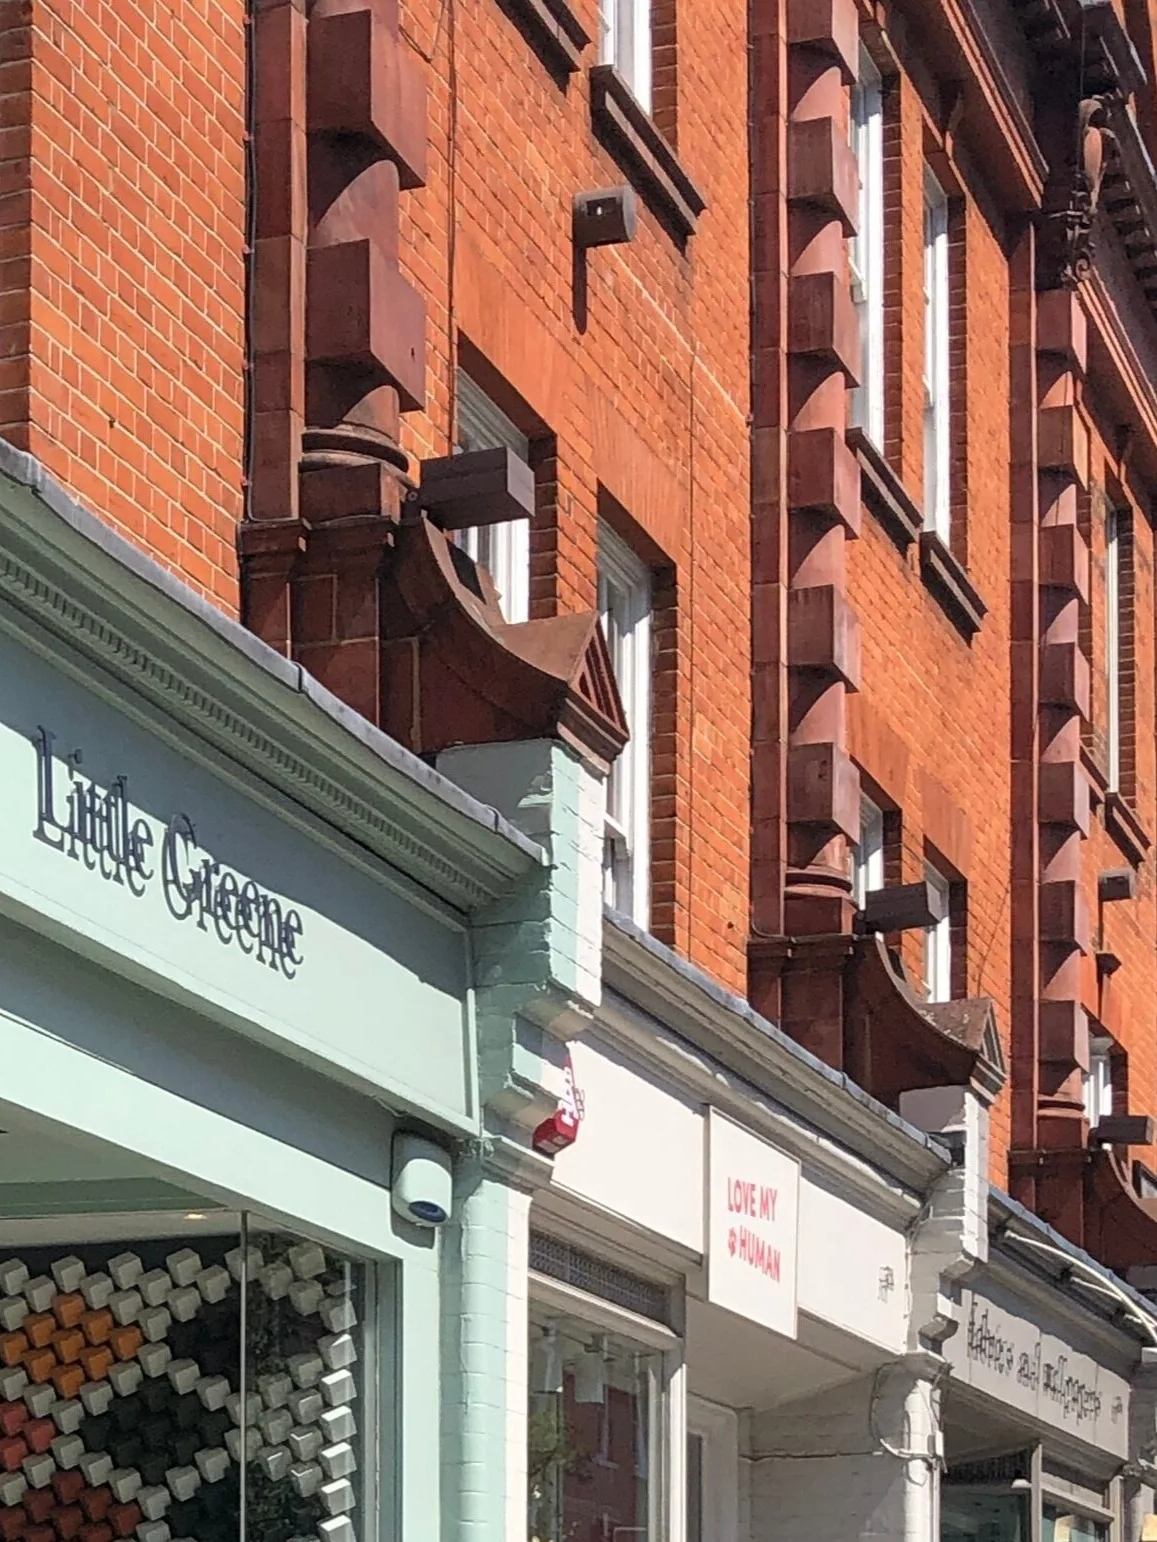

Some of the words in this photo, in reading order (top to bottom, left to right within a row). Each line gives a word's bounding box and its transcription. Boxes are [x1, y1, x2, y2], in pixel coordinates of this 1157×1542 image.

[32, 724, 154, 897] Little
[161, 812, 304, 980] Greene
[727, 1177, 756, 1218] LOVE
[759, 1185, 778, 1222] MY
[739, 1225, 781, 1284] HUMAN
